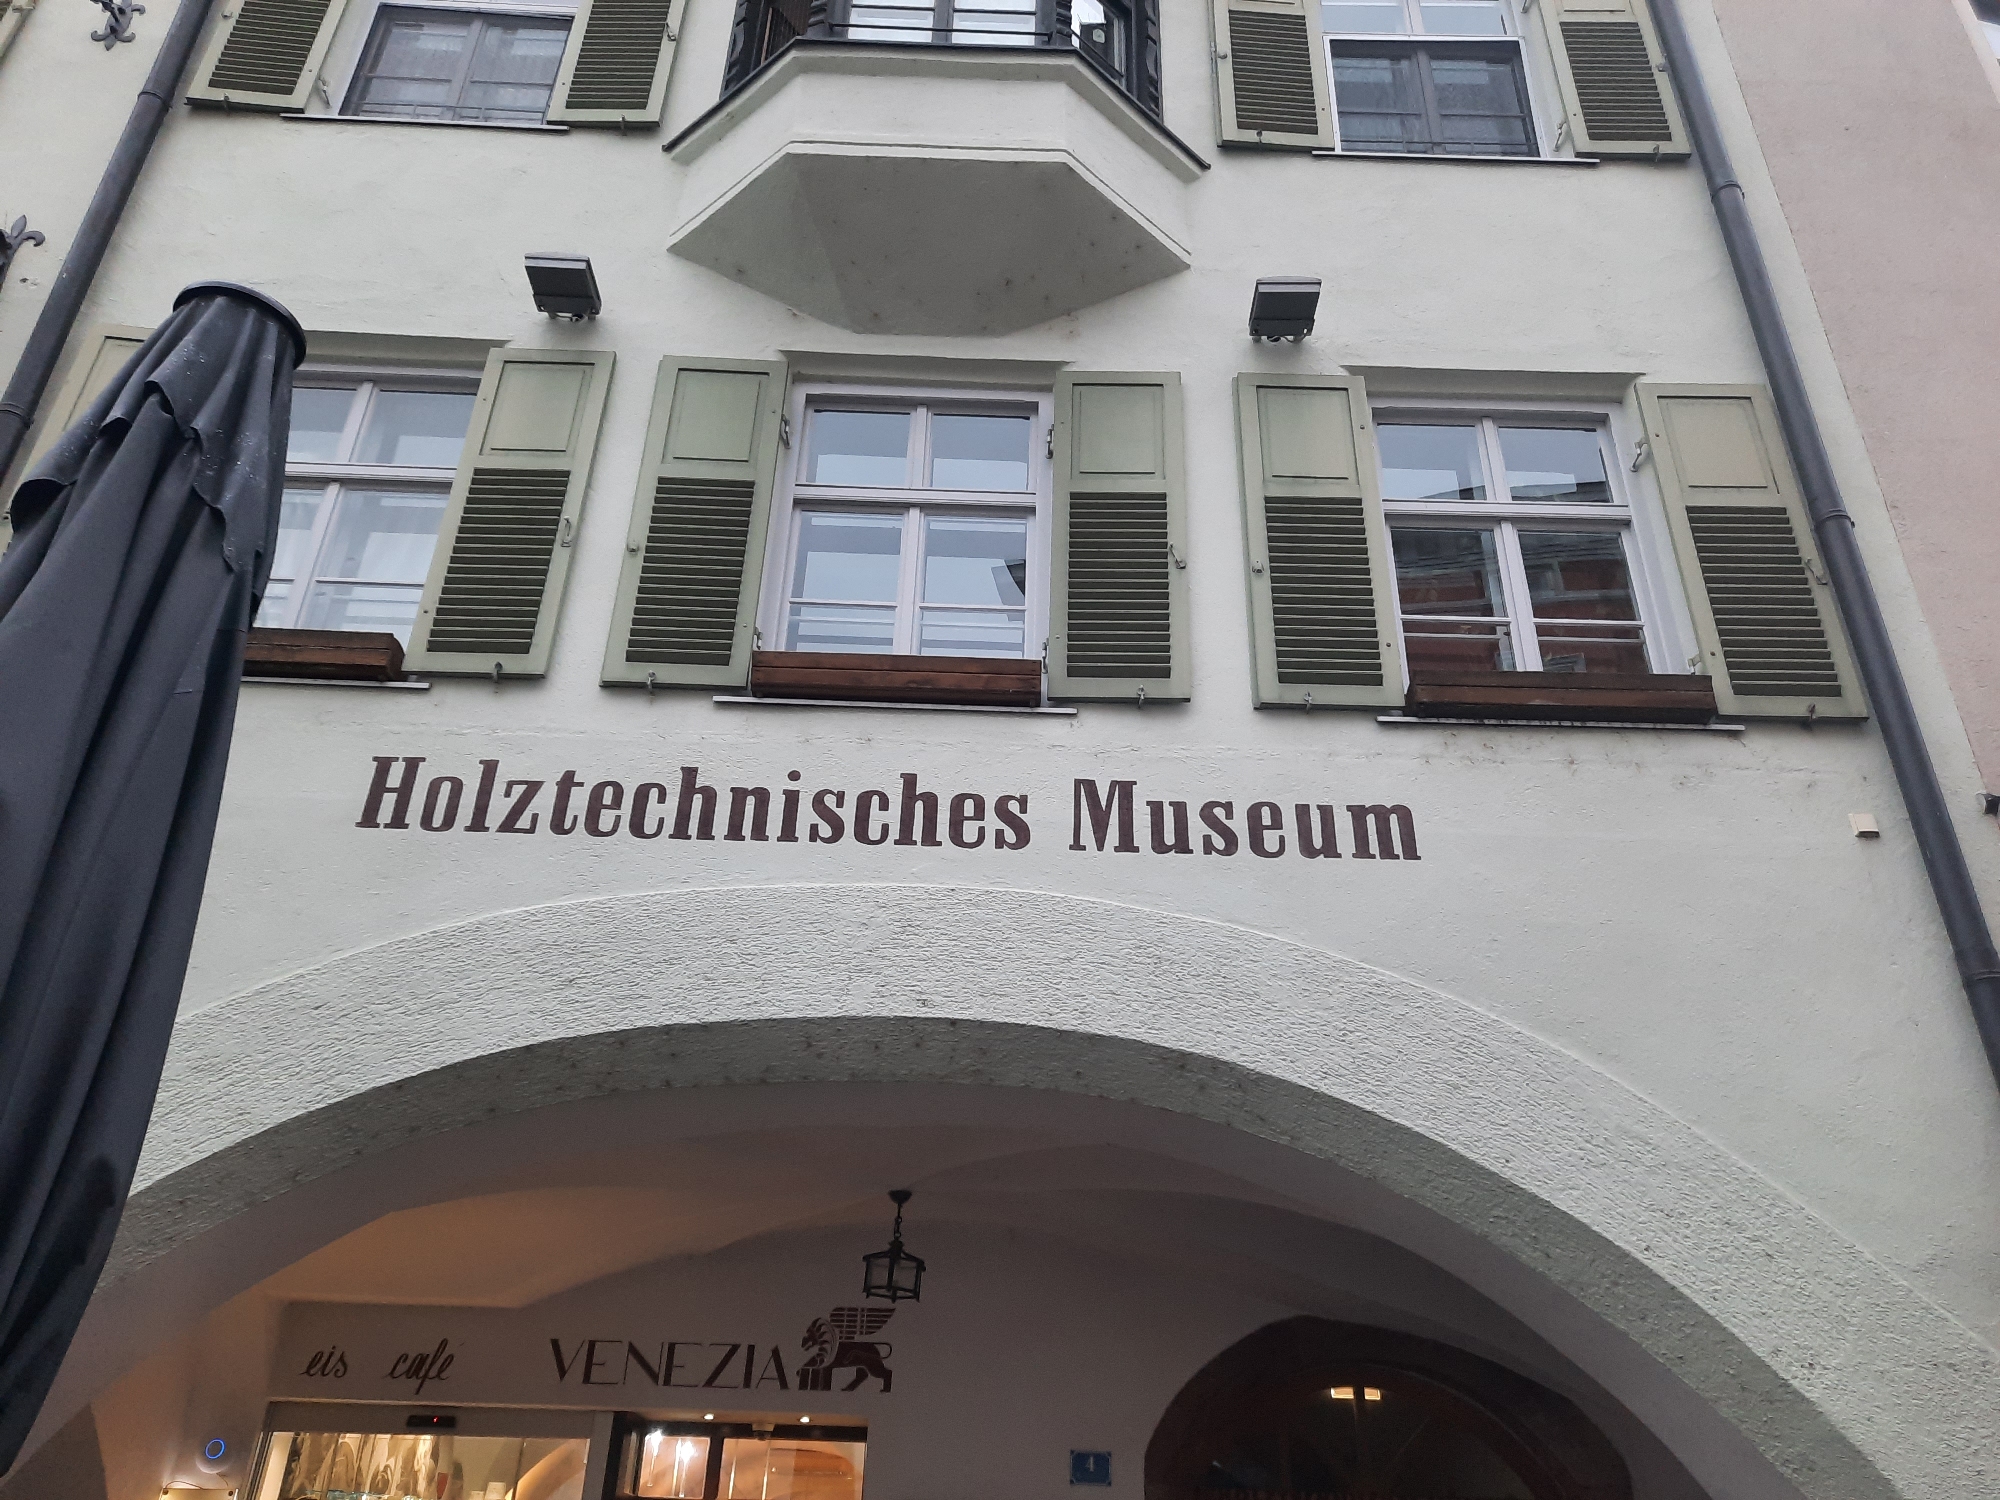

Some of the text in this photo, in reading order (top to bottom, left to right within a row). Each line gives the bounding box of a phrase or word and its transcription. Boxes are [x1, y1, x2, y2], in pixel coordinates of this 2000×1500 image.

[354, 755, 1422, 861] Holztechnisches Museum
[301, 1338, 789, 1395] eis café VENEZIA
